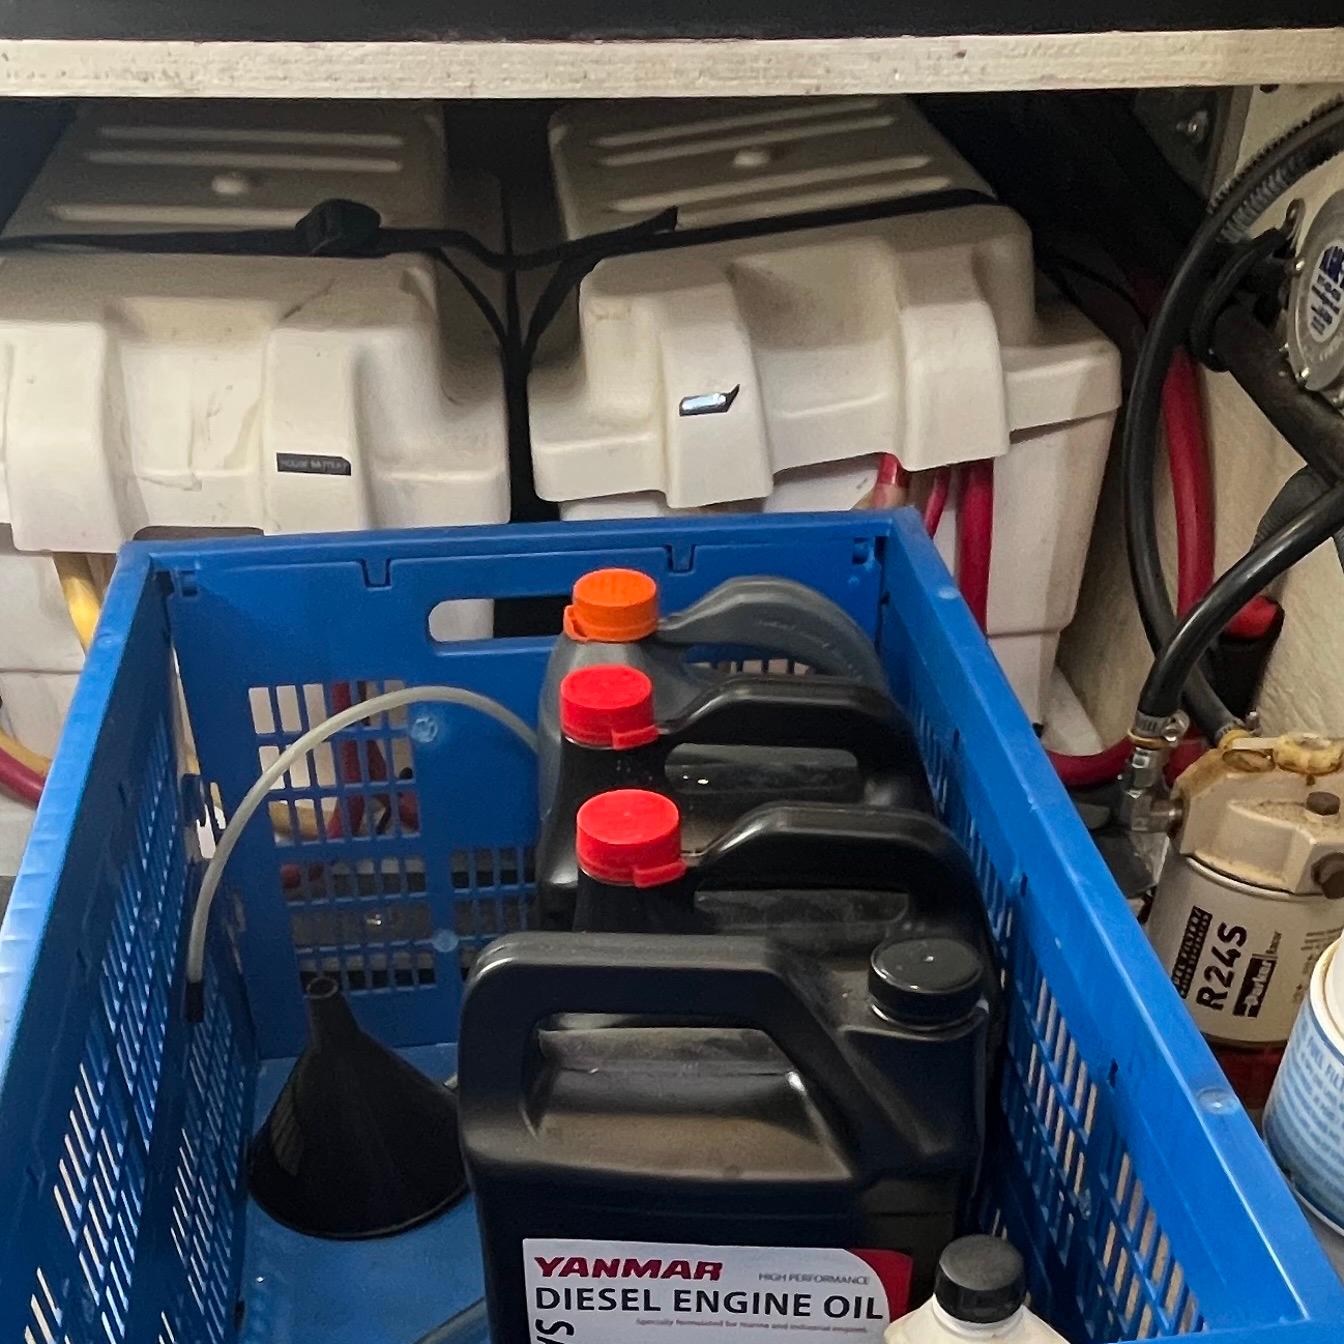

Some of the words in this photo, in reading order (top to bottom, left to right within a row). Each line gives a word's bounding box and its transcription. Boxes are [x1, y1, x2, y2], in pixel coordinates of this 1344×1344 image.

[1195, 921, 1248, 1011] R24S
[1243, 960, 1273, 1017] Parker
[534, 1256, 723, 1281] YANMAR
[535, 1287, 662, 1312] DIESEL
[673, 1289, 811, 1317] ENGINE
[823, 1294, 884, 1320] OIL
